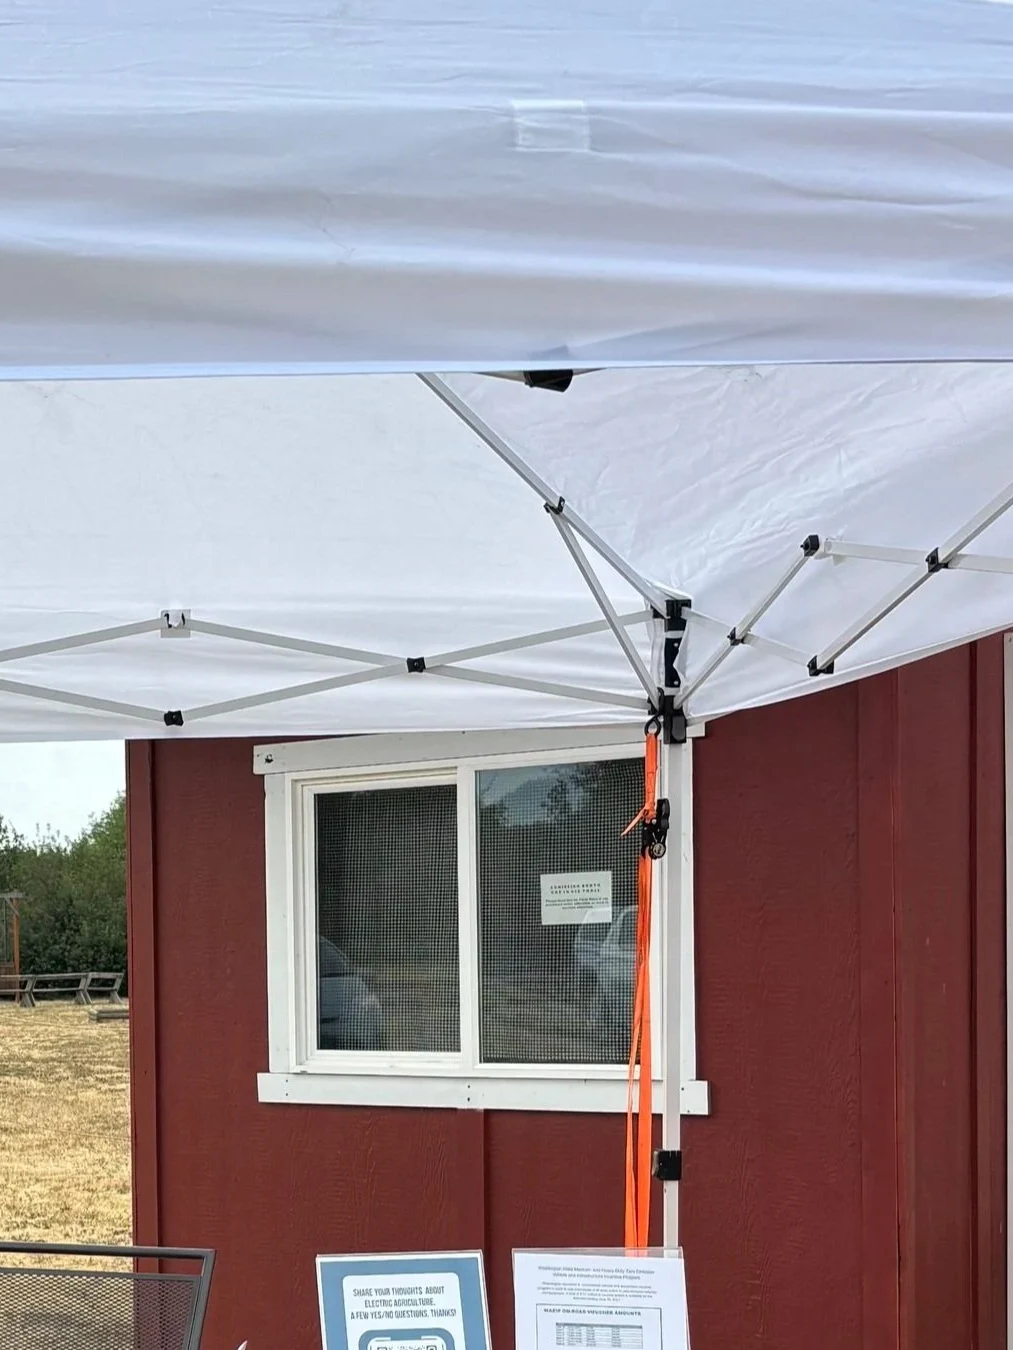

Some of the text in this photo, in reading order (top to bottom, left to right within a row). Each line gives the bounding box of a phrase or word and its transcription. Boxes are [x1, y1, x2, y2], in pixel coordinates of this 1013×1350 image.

[352, 1286, 445, 1297] SHARE YOUR THOUGHTS ABOUT
[364, 1297, 436, 1308] ELECTRIC AGRICULTURE.
[356, 1311, 369, 1320] FEW
[370, 1311, 394, 1320] YES/NO
[431, 1308, 457, 1317] THANKS!
